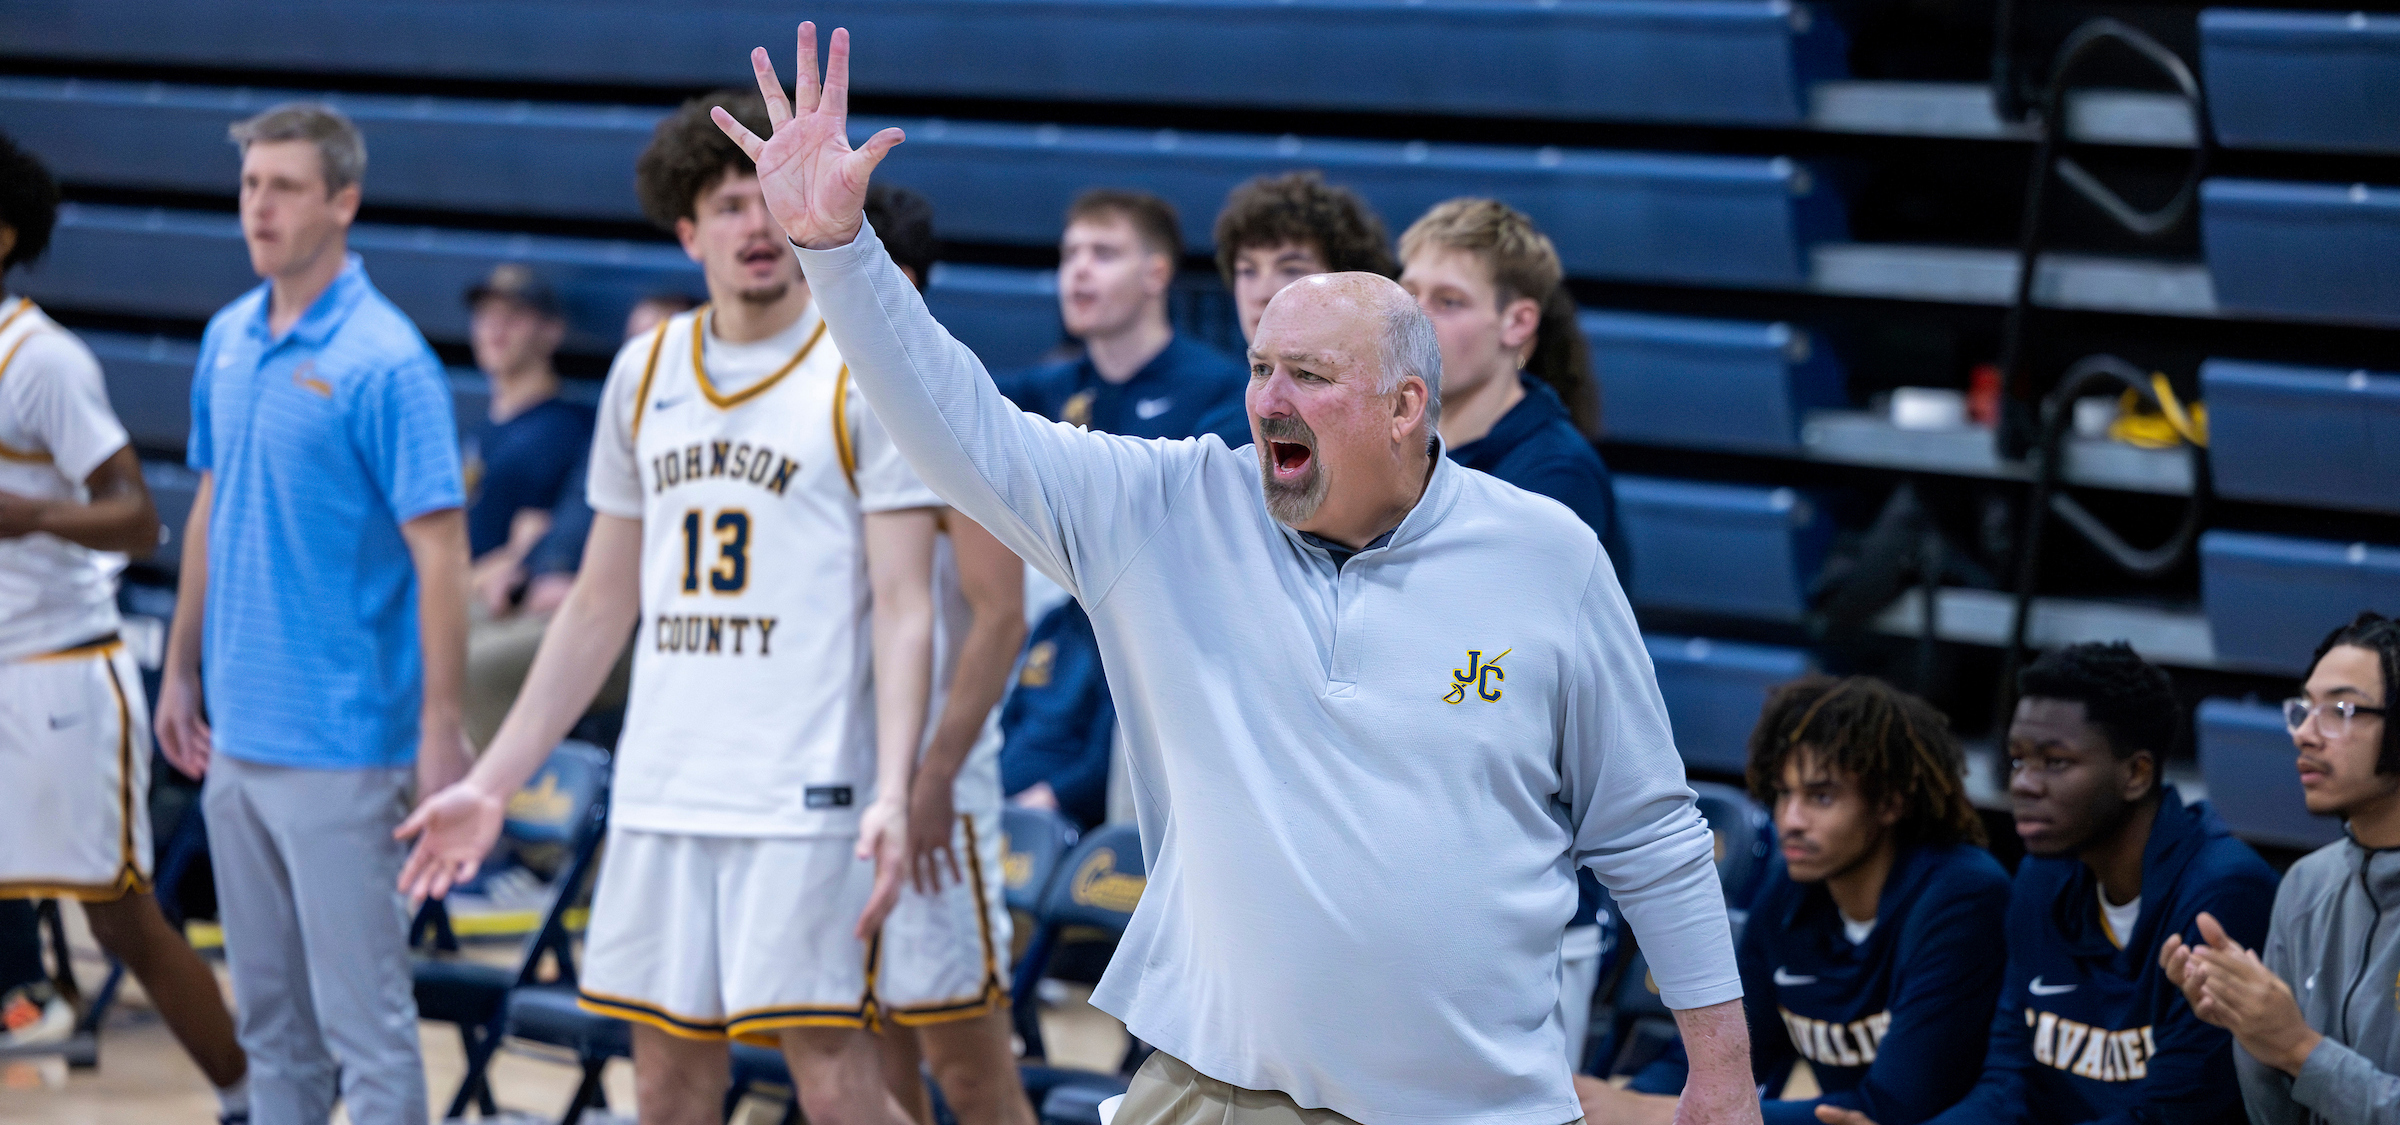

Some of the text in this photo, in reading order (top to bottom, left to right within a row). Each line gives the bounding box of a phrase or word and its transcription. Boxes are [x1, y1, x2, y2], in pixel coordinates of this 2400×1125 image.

[653, 440, 800, 496] JOHNSON
[682, 508, 753, 597] 13
[656, 616, 777, 656] COUNTY
[1452, 650, 1505, 703] JC
